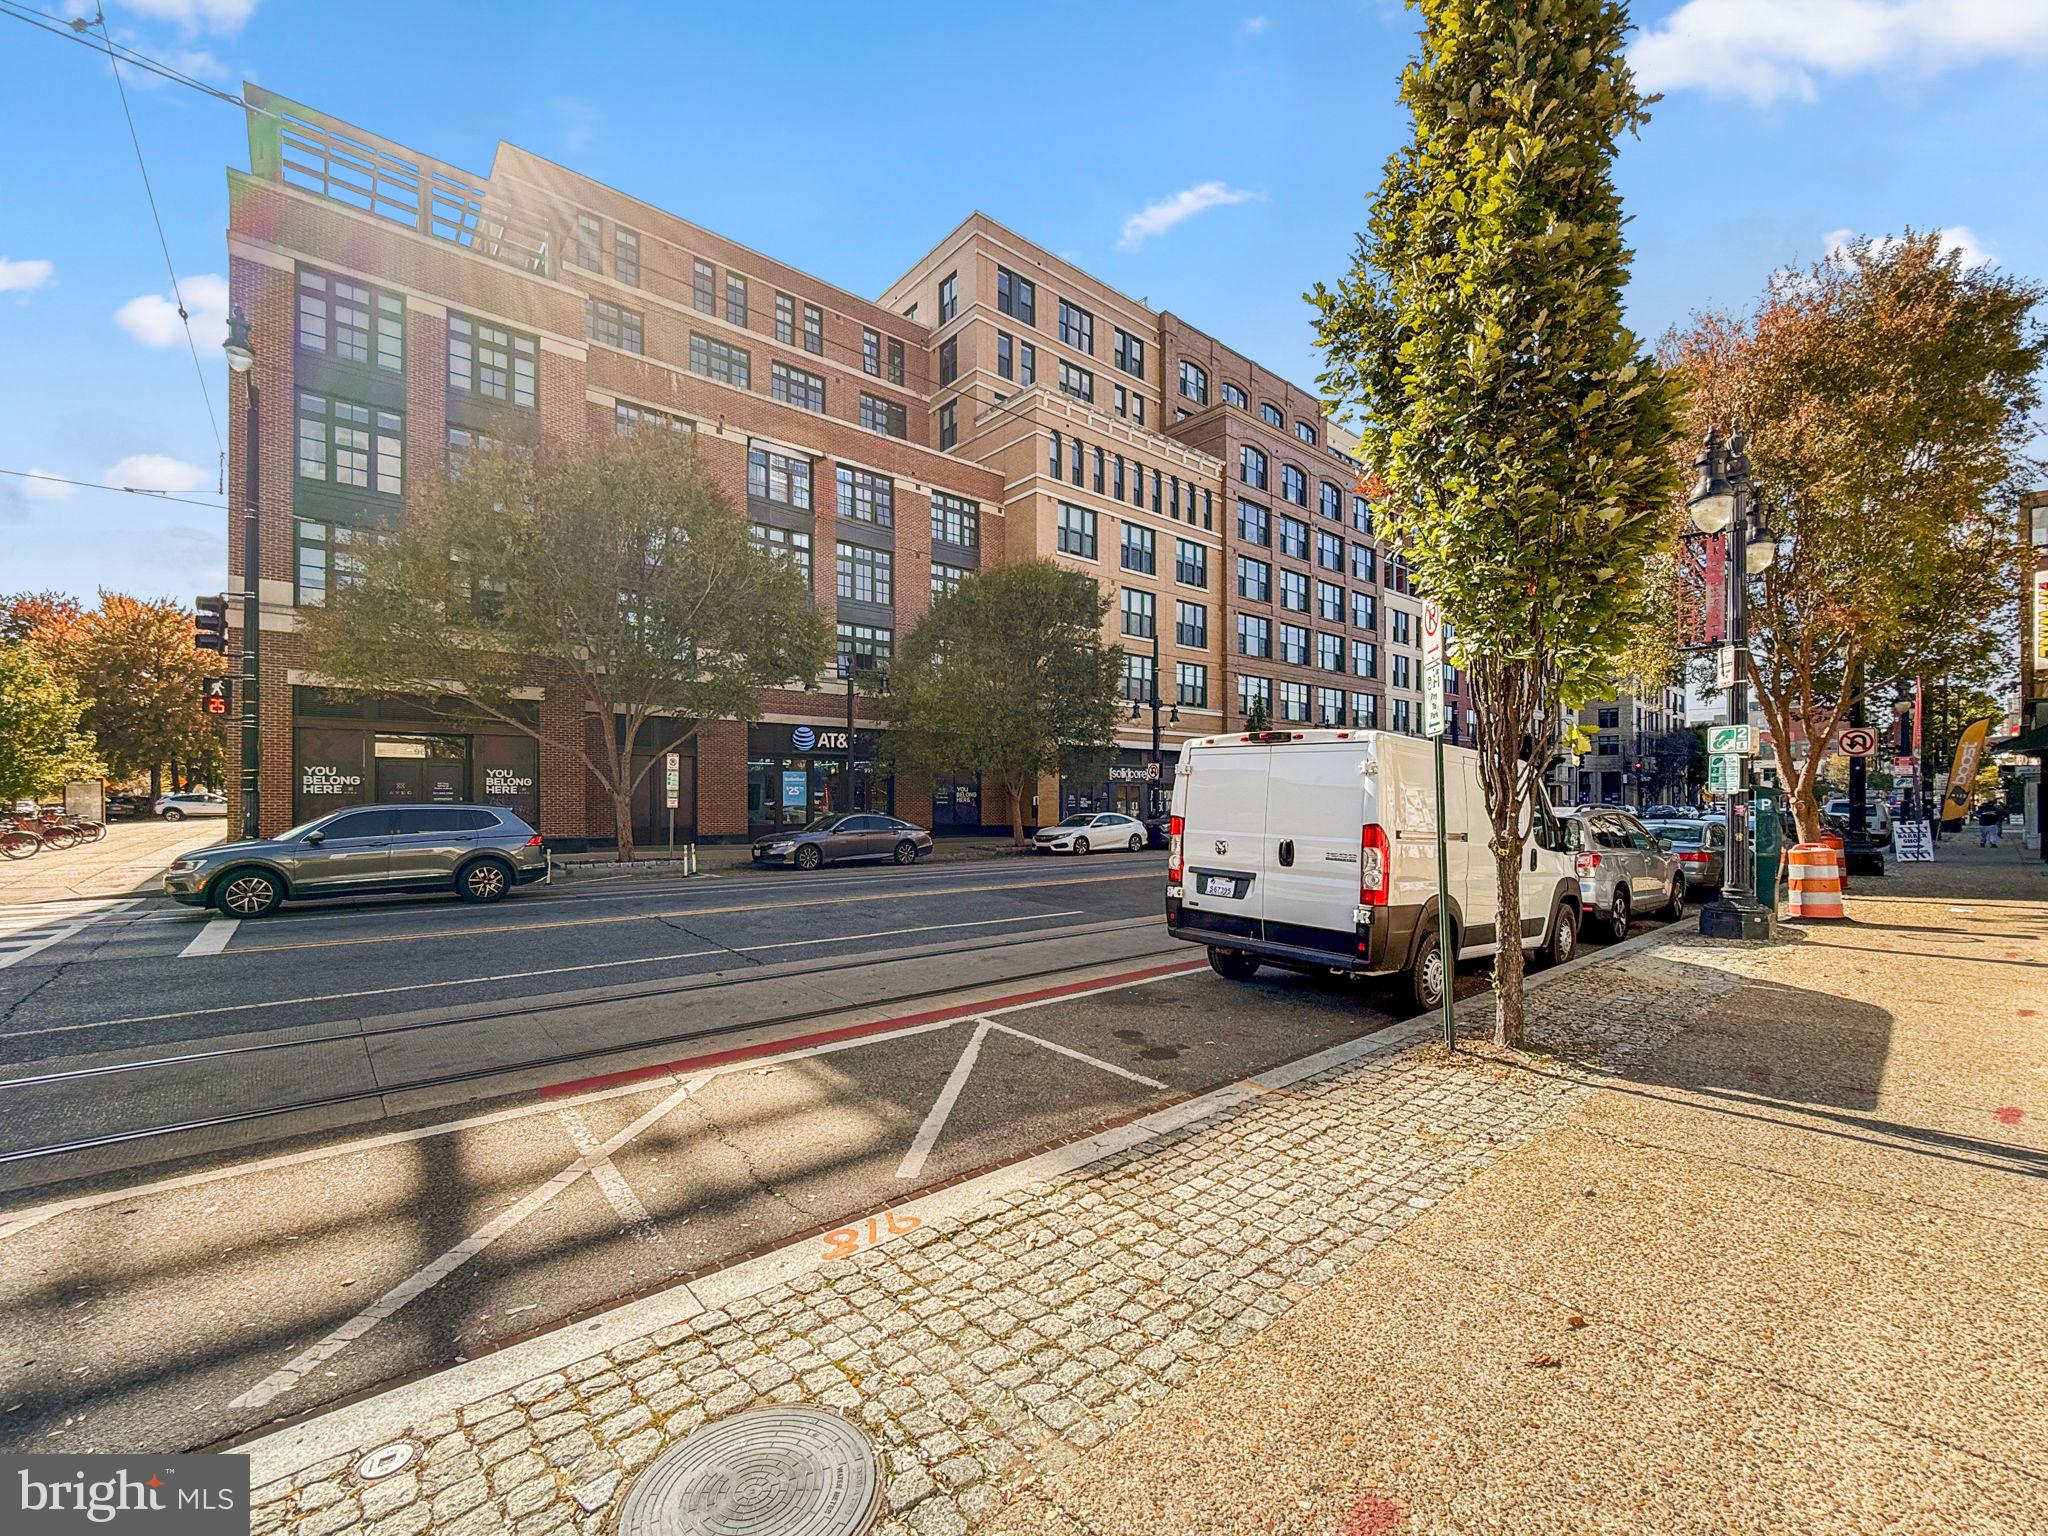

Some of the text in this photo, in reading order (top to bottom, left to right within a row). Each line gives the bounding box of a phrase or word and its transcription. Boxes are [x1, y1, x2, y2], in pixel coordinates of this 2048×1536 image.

[209, 698, 225, 713] 25
[1737, 727, 1747, 738] 2
[817, 733, 857, 748] AT&
[304, 766, 337, 776] YOU
[486, 769, 513, 778] YOU
[303, 775, 361, 785] BELONG
[485, 777, 533, 786] BELONG
[302, 785, 343, 794] HERE
[485, 786, 518, 794] HERE
[1761, 799, 1772, 810] P
[823, 1466, 845, 1515] WATER METER
